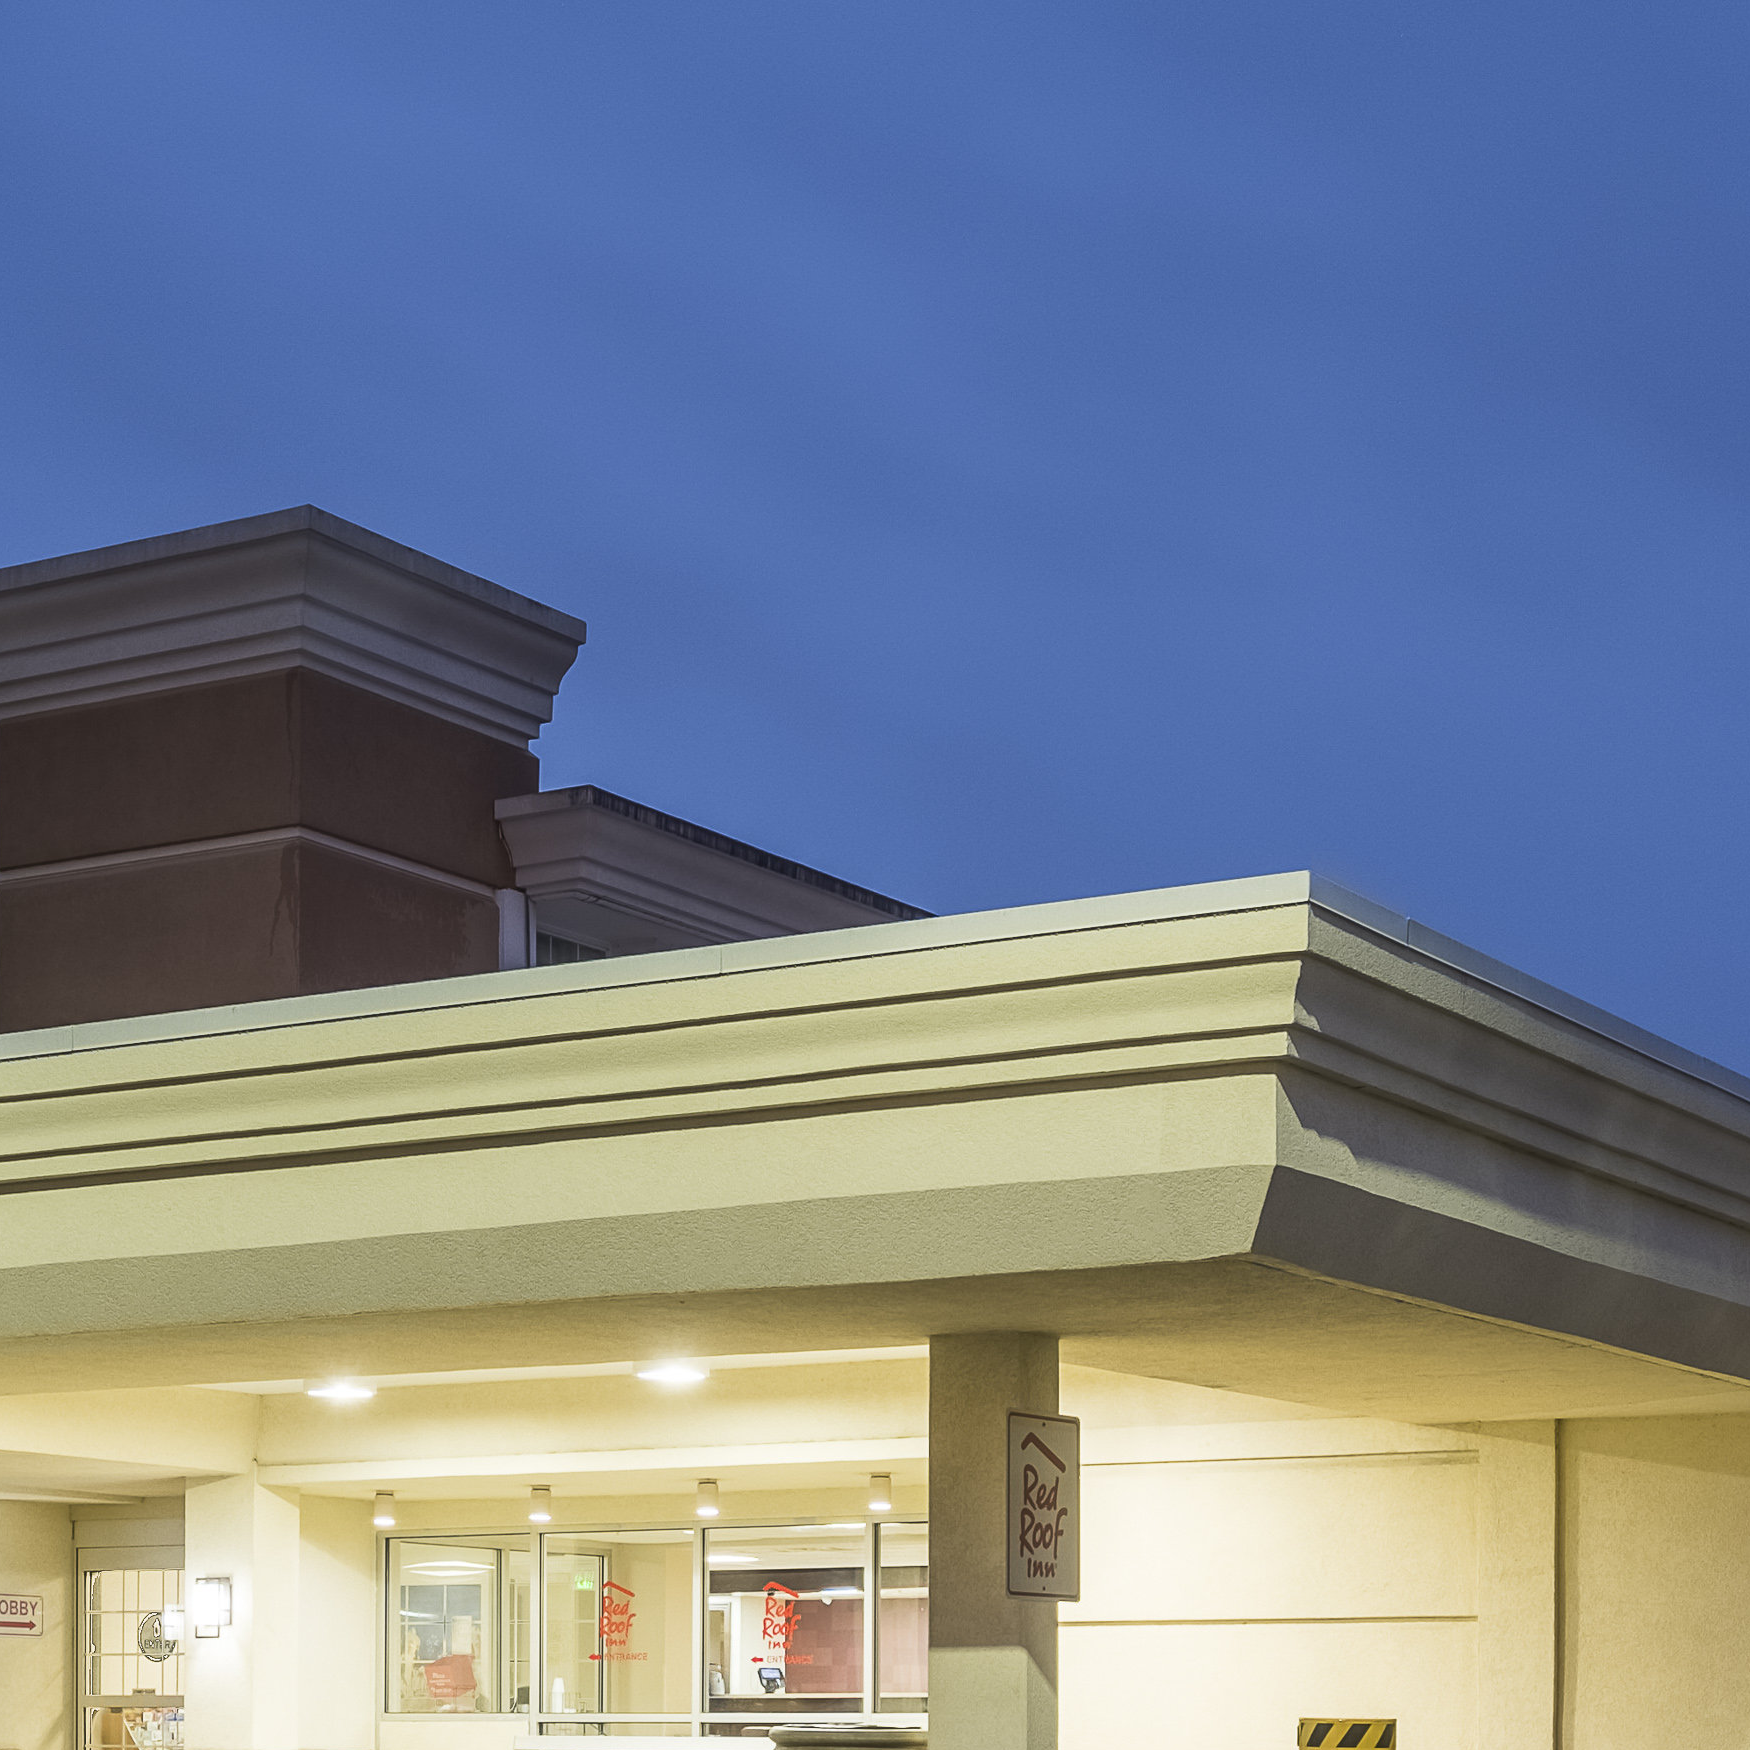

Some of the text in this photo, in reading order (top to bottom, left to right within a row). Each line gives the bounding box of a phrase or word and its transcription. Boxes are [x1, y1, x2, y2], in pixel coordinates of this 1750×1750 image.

[1023, 1463, 1060, 1511] Red
[1019, 1507, 1068, 1560] Roof
[603, 1596, 630, 1617] Red
[765, 1596, 795, 1618] Red
[600, 1613, 636, 1638] Roof
[762, 1614, 801, 1640] Roof
